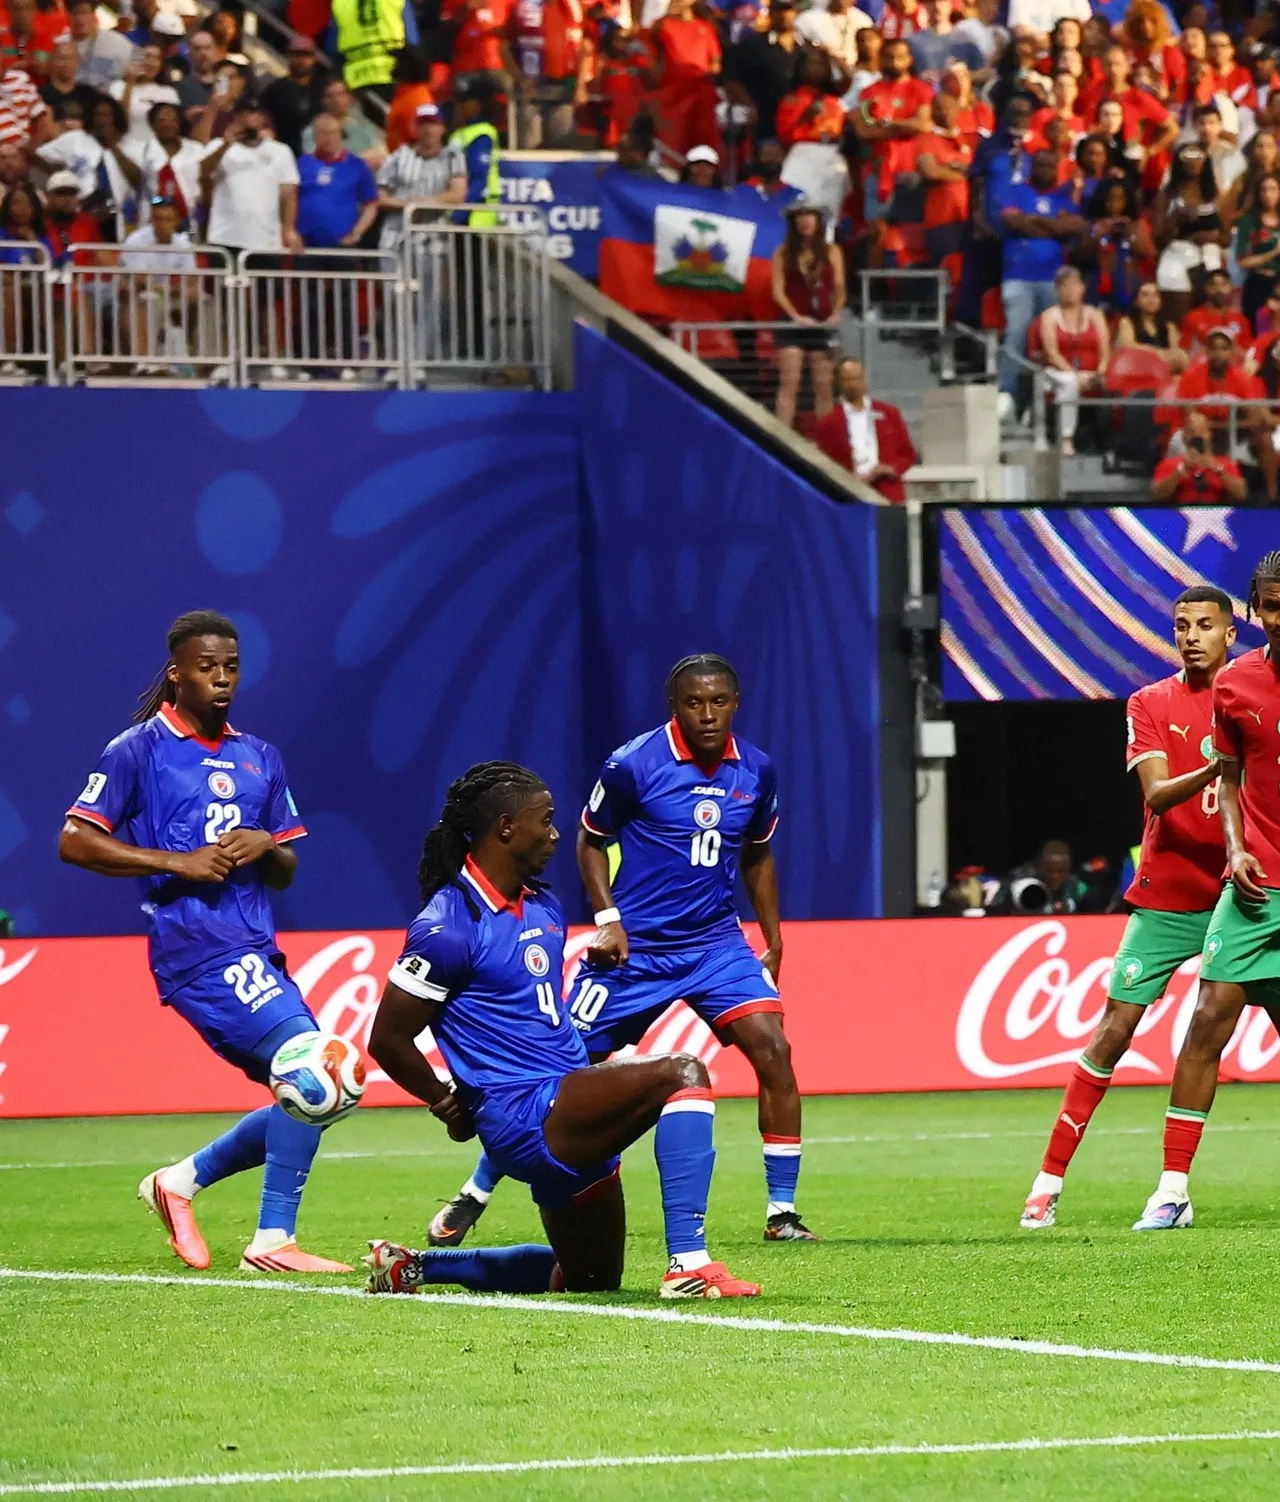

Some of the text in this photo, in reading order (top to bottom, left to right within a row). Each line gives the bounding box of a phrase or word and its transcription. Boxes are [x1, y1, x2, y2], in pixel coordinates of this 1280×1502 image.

[689, 786, 726, 797] SAETA
[205, 802, 242, 844] 22
[690, 829, 722, 868] 10
[518, 927, 544, 942] AETA
[223, 953, 278, 1005] 22
[250, 986, 284, 1014] SAETA
[536, 981, 560, 1027] 4
[570, 978, 609, 1023] 10
